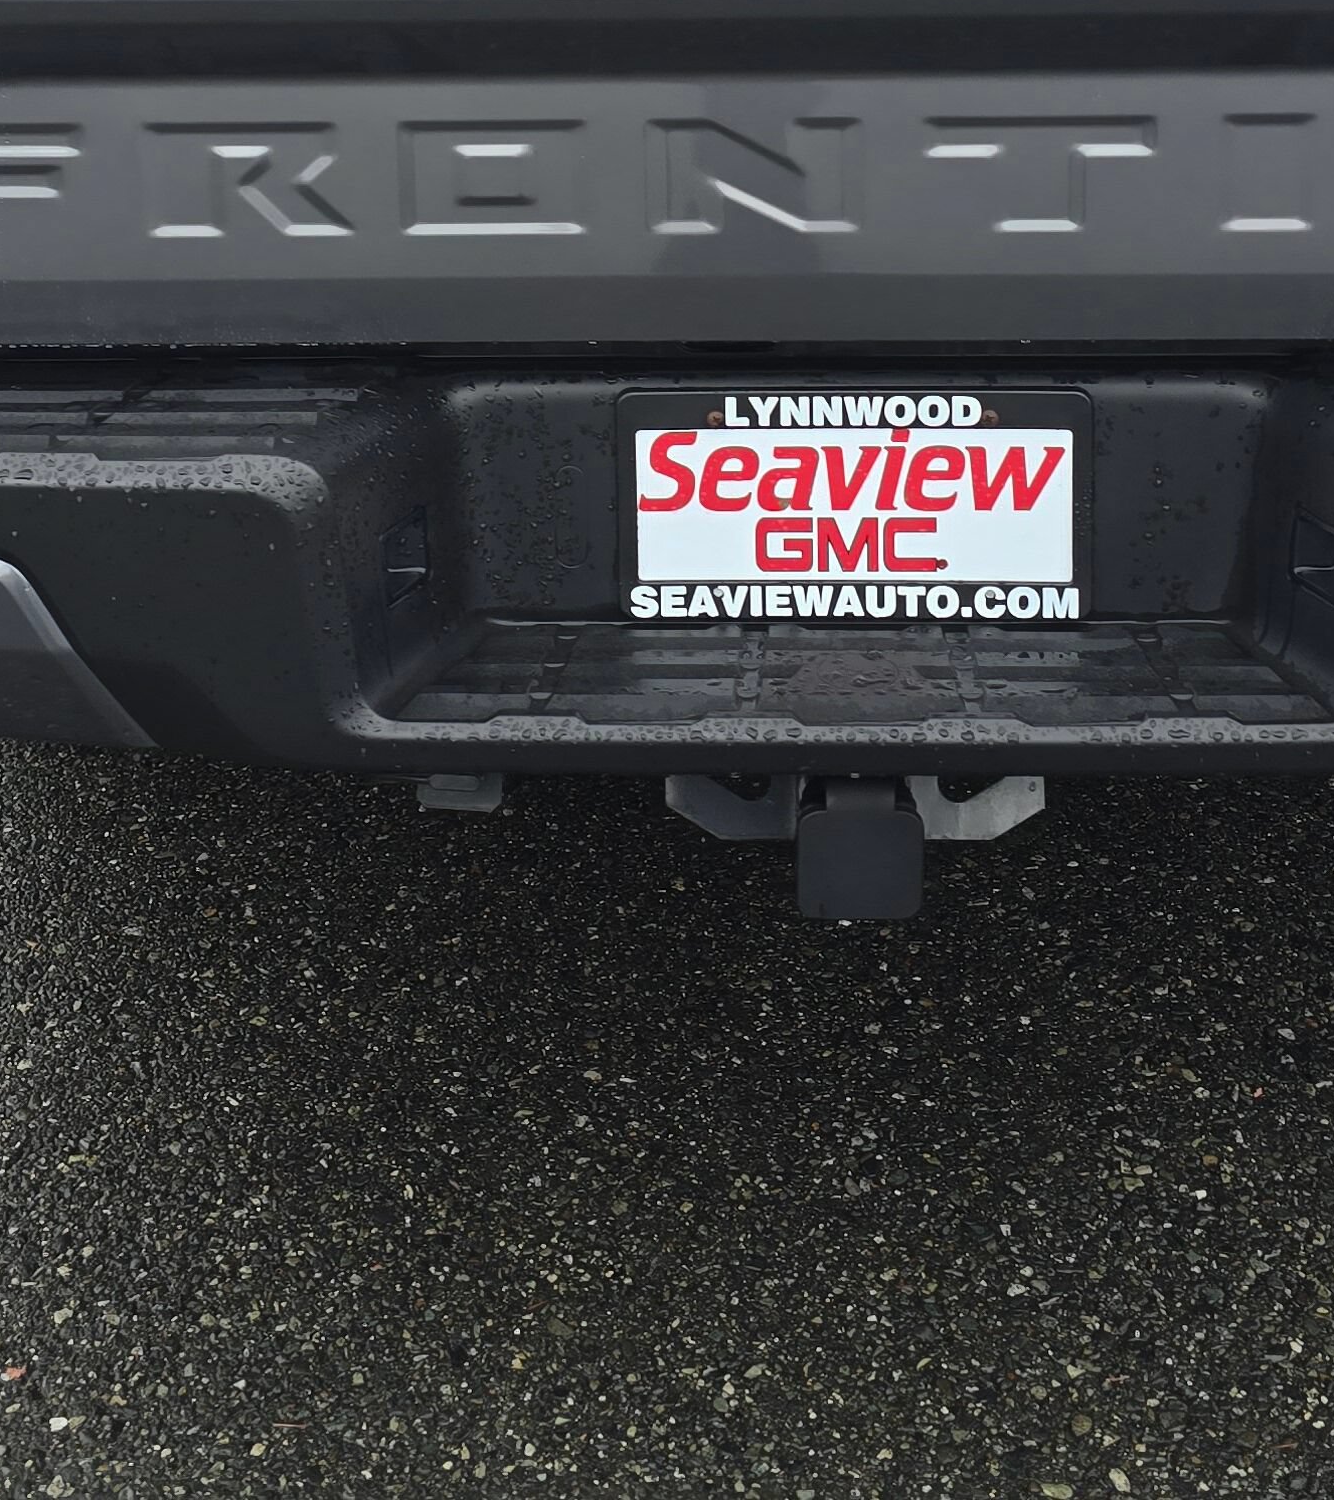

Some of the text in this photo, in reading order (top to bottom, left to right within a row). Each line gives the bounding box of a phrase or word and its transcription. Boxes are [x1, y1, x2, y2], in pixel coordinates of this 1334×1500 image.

[723, 395, 983, 428] LYNNWOOD
[639, 429, 1066, 512] Seaview
[754, 516, 941, 573] GMC
[630, 585, 1080, 620] SEAVIEWAUTO.COM
